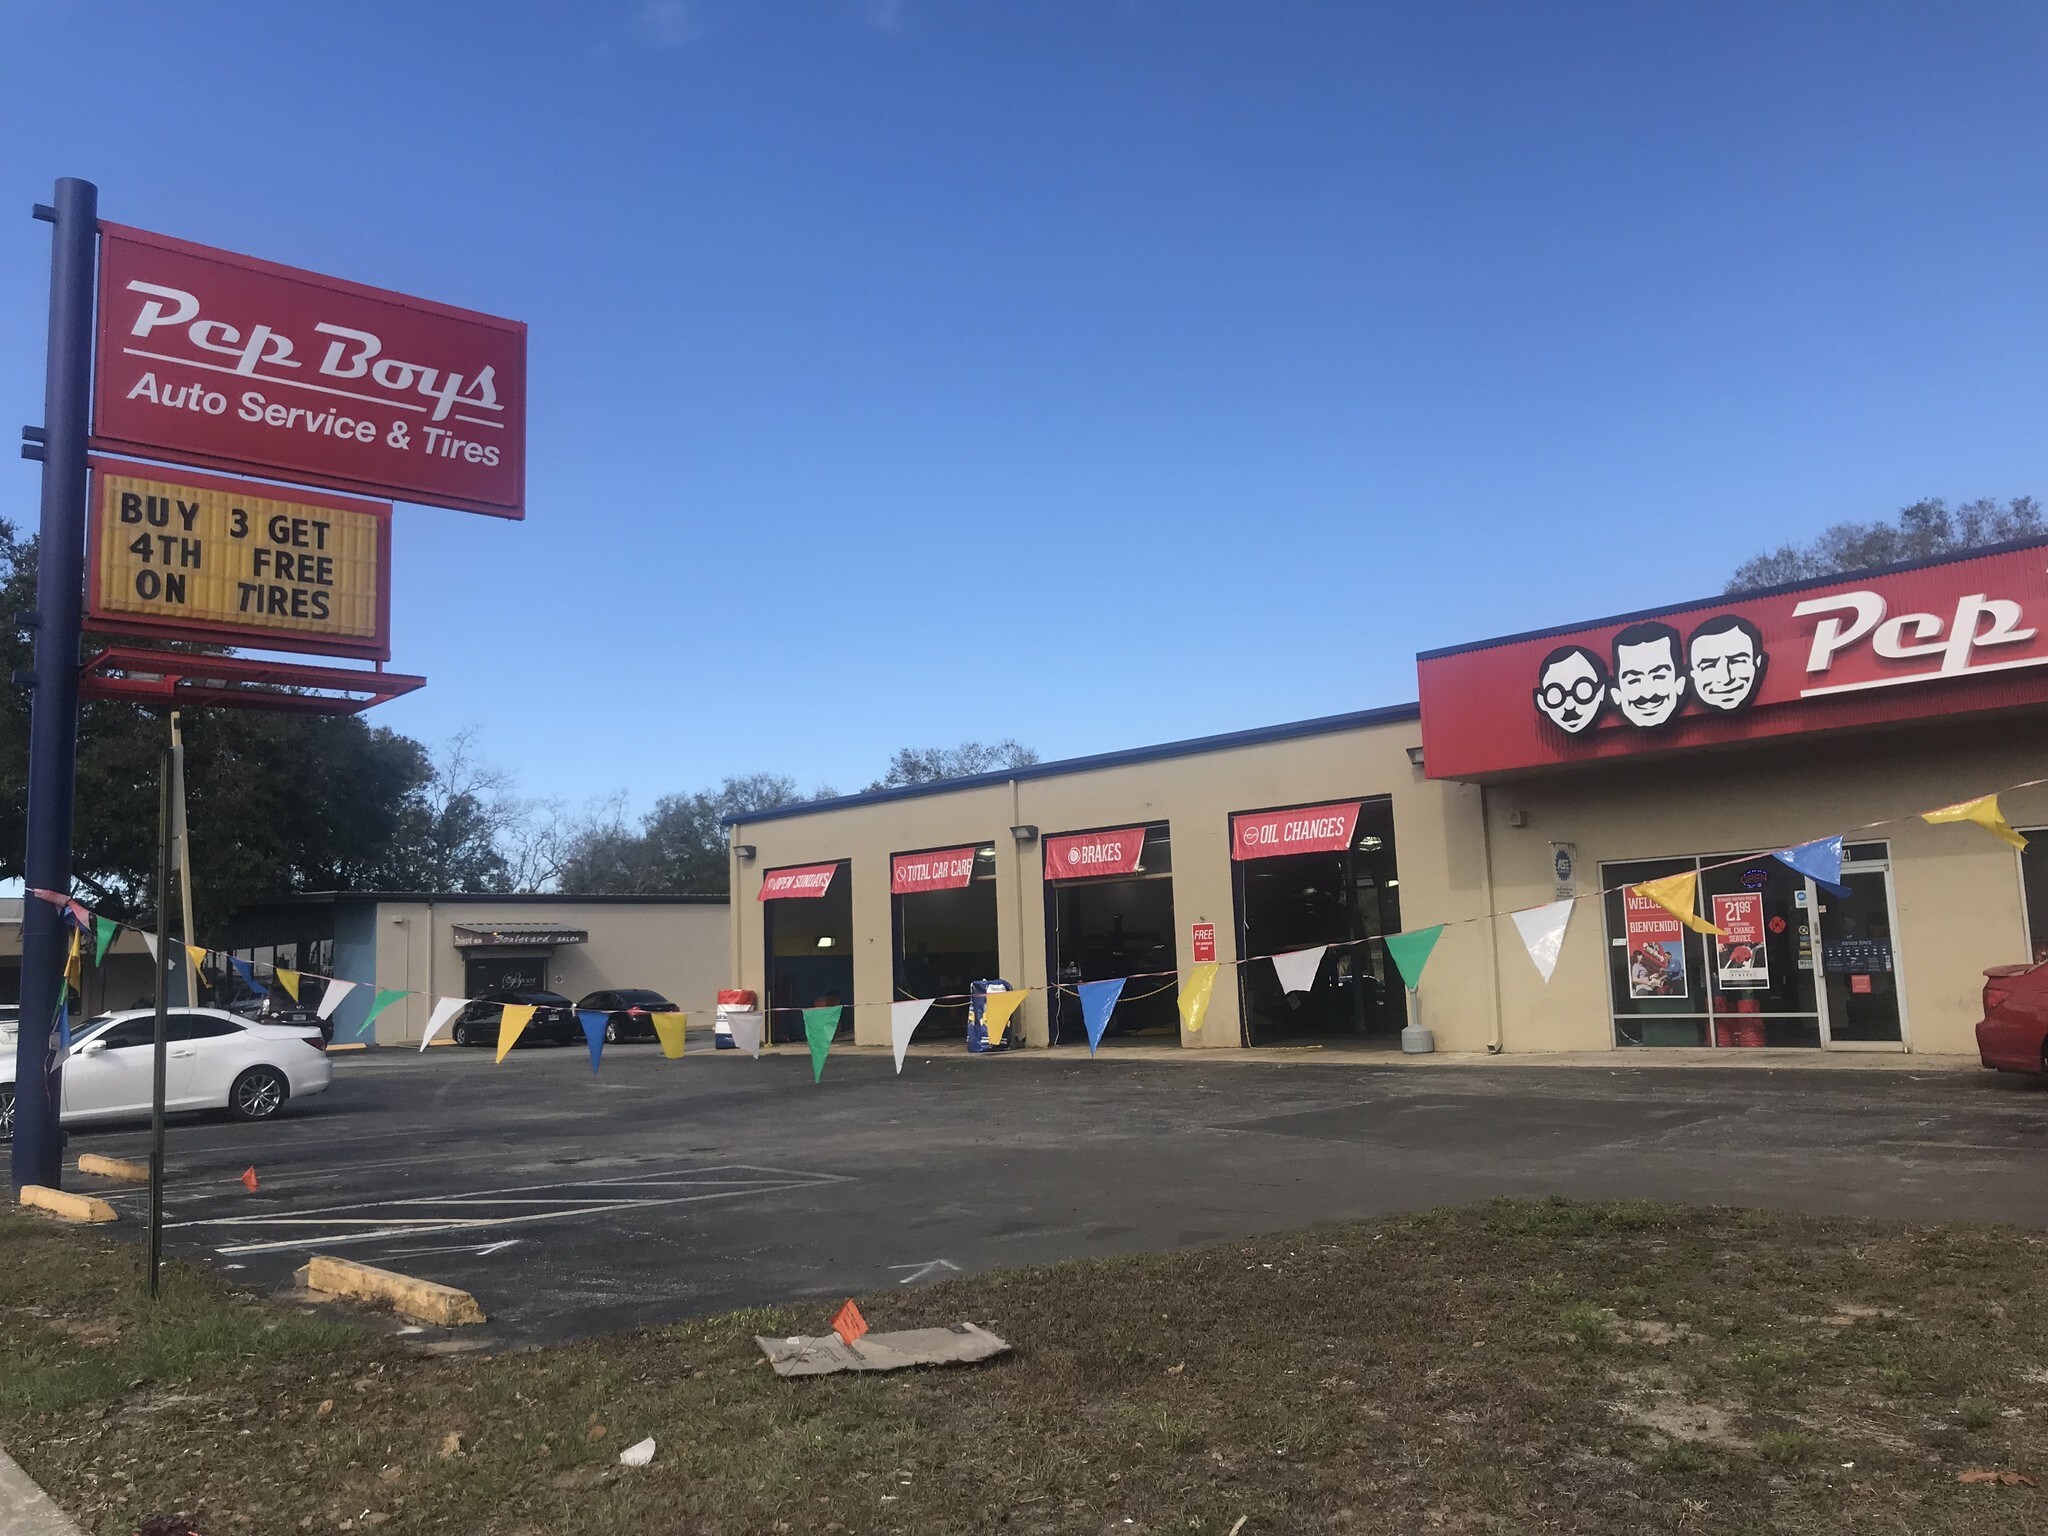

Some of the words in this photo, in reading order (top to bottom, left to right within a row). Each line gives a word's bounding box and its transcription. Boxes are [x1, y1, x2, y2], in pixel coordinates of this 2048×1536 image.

[126, 279, 302, 374] Pep
[314, 321, 505, 421] Boys
[127, 372, 228, 416] Auto
[238, 391, 377, 443] Service
[386, 420, 410, 450] &
[422, 425, 501, 467] Tires
[121, 492, 199, 531] BUY
[229, 508, 249, 539] 3
[268, 515, 330, 550] GET
[129, 532, 202, 569] 4TH
[253, 547, 333, 586] FREE
[136, 569, 186, 604] ON
[237, 582, 330, 620] TIRES
[1792, 590, 2039, 677] Pep
[1260, 824, 1279, 844] OIL
[1284, 816, 1345, 842] CHANGES
[1081, 842, 1122, 864] BRAKES
[772, 875, 796, 891] OPEN
[793, 872, 830, 889] SUNDAYS
[907, 863, 931, 882] TOTAL
[932, 861, 949, 879] CAR
[493, 934, 551, 944] Boulevard
[1194, 929, 1213, 940] FREE
[1629, 920, 1679, 933] BIENVENIDO
